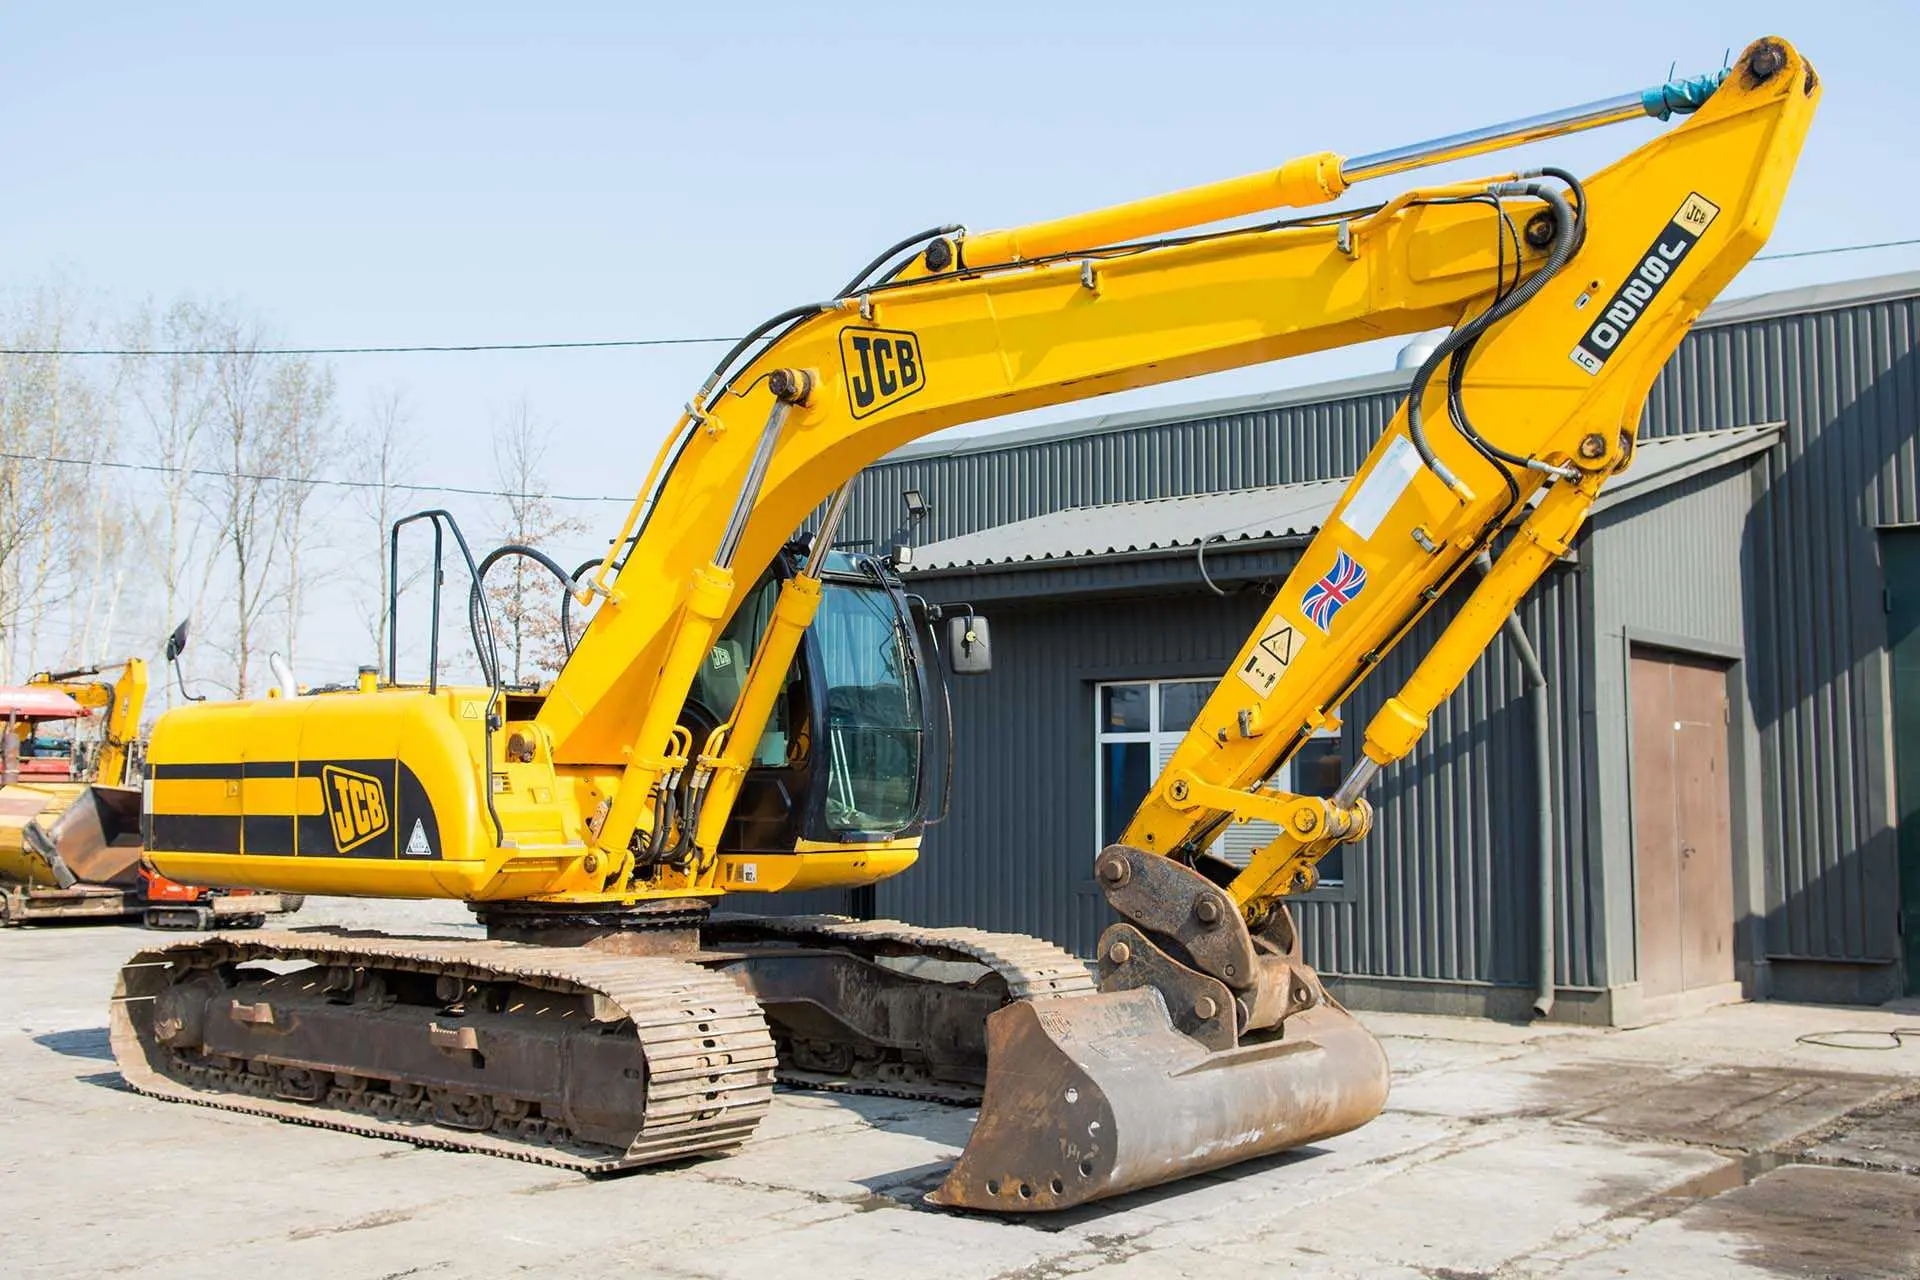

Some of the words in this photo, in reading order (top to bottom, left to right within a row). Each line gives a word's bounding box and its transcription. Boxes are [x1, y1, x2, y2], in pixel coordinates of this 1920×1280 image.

[1686, 204, 1706, 224] JCB
[1590, 240, 1688, 350] JS220
[852, 336, 918, 408] JCB
[1577, 352, 1595, 368] LC
[333, 774, 385, 843] JCB
